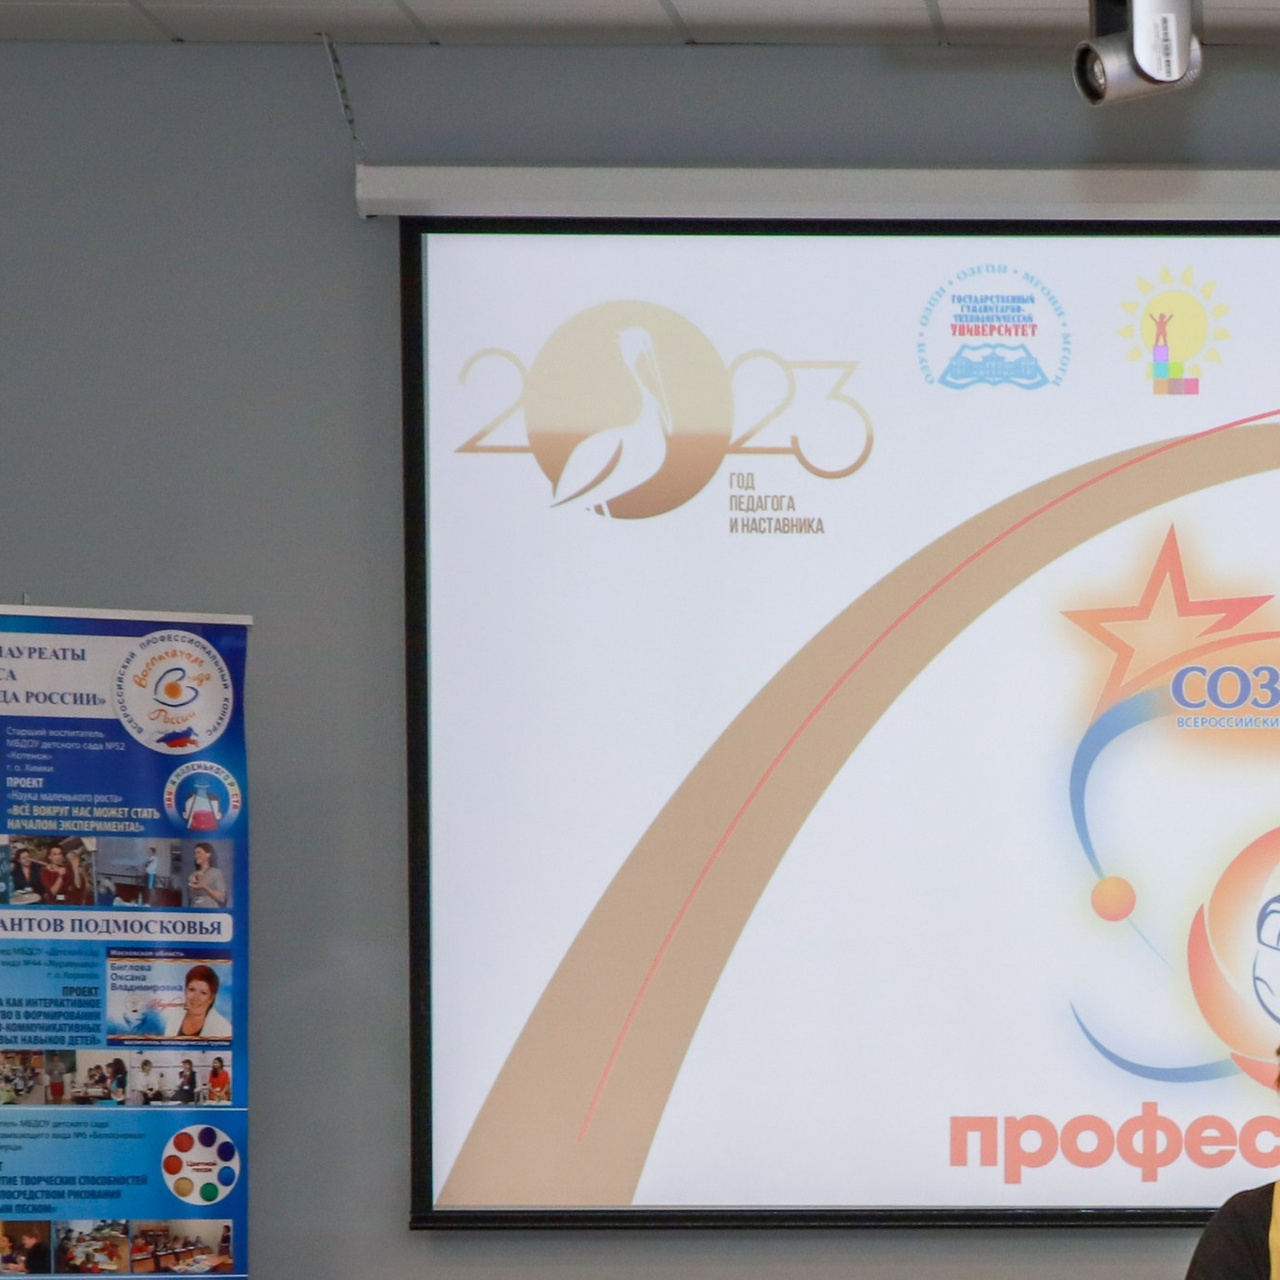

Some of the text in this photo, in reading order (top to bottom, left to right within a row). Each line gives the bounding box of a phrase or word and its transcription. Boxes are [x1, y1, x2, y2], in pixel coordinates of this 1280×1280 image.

[950, 323, 1038, 337] УНИВЕРСИТЕТ
[729, 472, 755, 491] ГОД
[729, 495, 796, 513] ПЕДАГОГА
[729, 517, 825, 534] И НАСТАВНИКА
[6, 777, 44, 788] ПРОЕКТ
[32, 806, 69, 817] ВОКРУГ
[72, 807, 91, 818] НАС
[93, 807, 129, 819] МОЖЕТ
[131, 808, 161, 819] СТАТЬ
[7, 819, 57, 831] НАЧАЛОМ
[70, 918, 222, 935] ПОДМОСКОВЬЯ
[110, 972, 147, 982] Оксана
[62, 986, 99, 997] ПРОЕКТ
[110, 982, 183, 994] Владимировна
